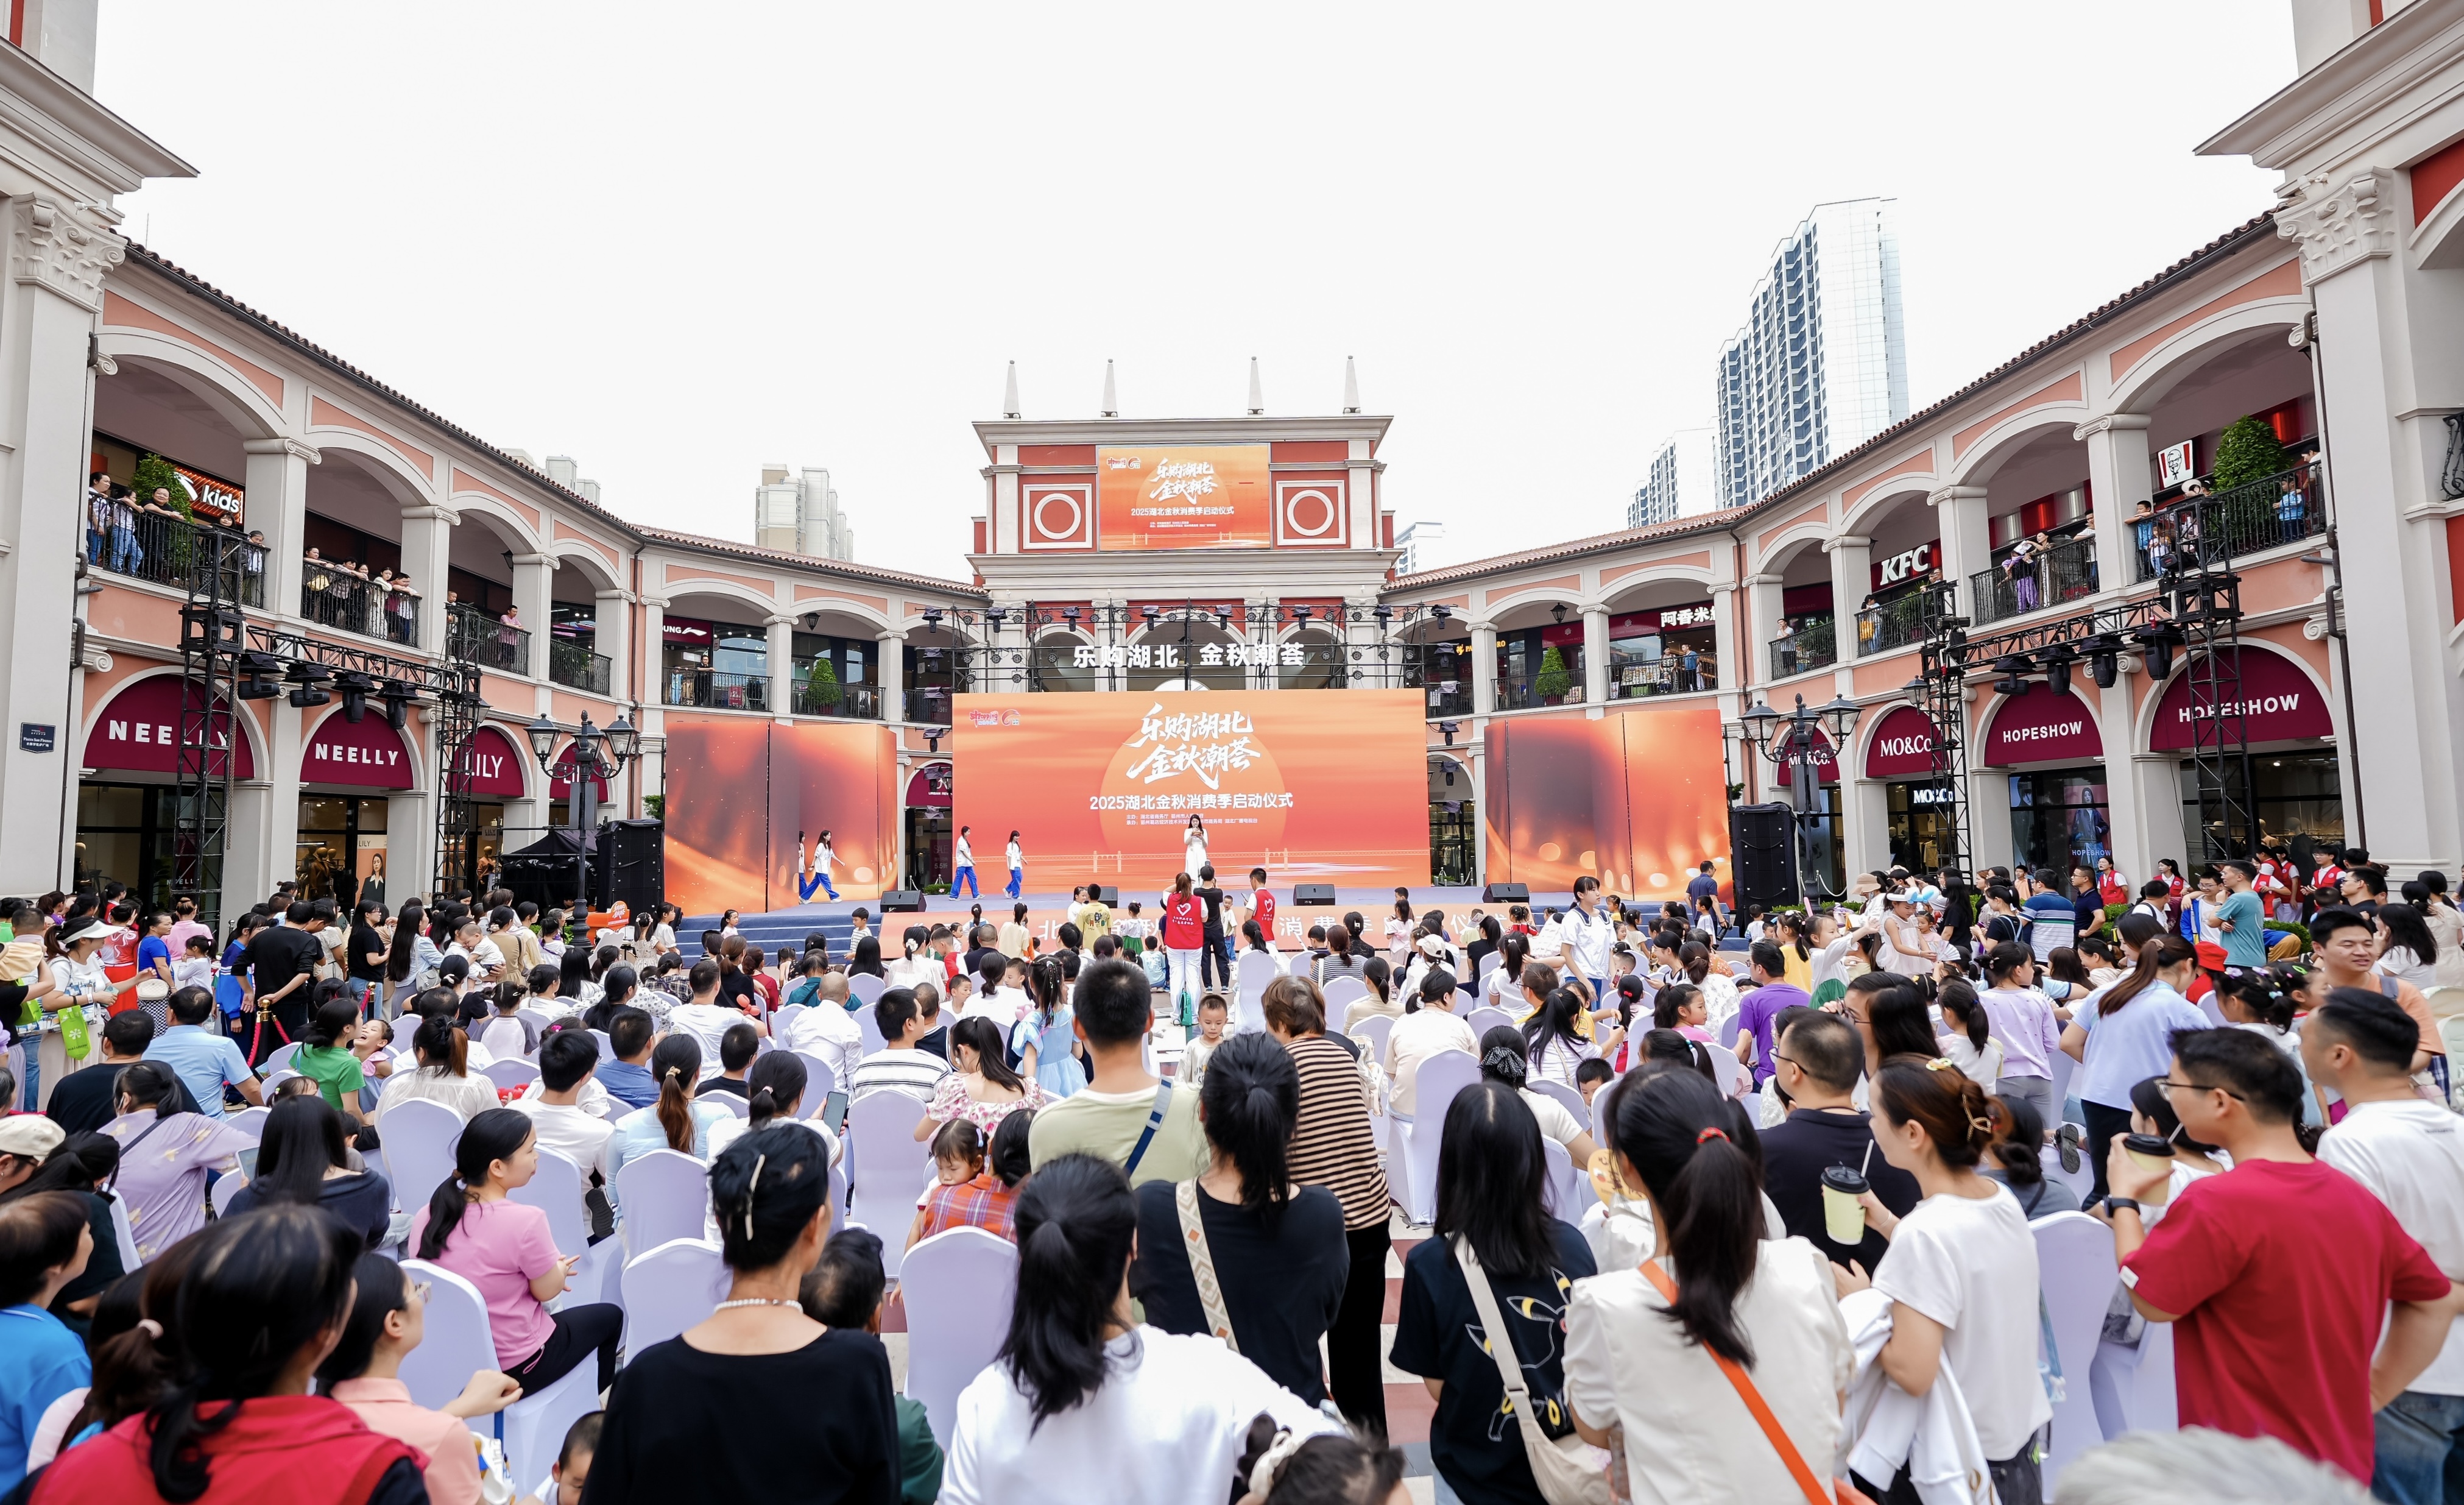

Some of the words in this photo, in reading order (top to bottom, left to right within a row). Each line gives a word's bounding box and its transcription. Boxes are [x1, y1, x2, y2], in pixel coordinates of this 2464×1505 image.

[1148, 458, 1214, 483] 乐购湖北
[202, 484, 240, 513] kids
[1149, 476, 1218, 505] 金秋潮荟
[1131, 506, 1234, 517] 2025湖北金秋消费季启动仪式
[1880, 545, 1929, 586] KFC
[1073, 645, 1178, 668] 乐购湖北
[1199, 642, 1304, 667] 金秋潮荟
[2178, 693, 2299, 723] HOPESHOW
[1121, 702, 1254, 748] 乐购湖北
[2003, 721, 2082, 743] HOPESHOW
[315, 743, 398, 766] NEELLY
[465, 752, 503, 779] LILY
[1126, 736, 1261, 790] 金秋潮荟
[563, 765, 591, 784] LIL
[1089, 792, 1293, 811] 2025湖北金秋消费季启动仪式
[934, 845, 949, 854] SALE
